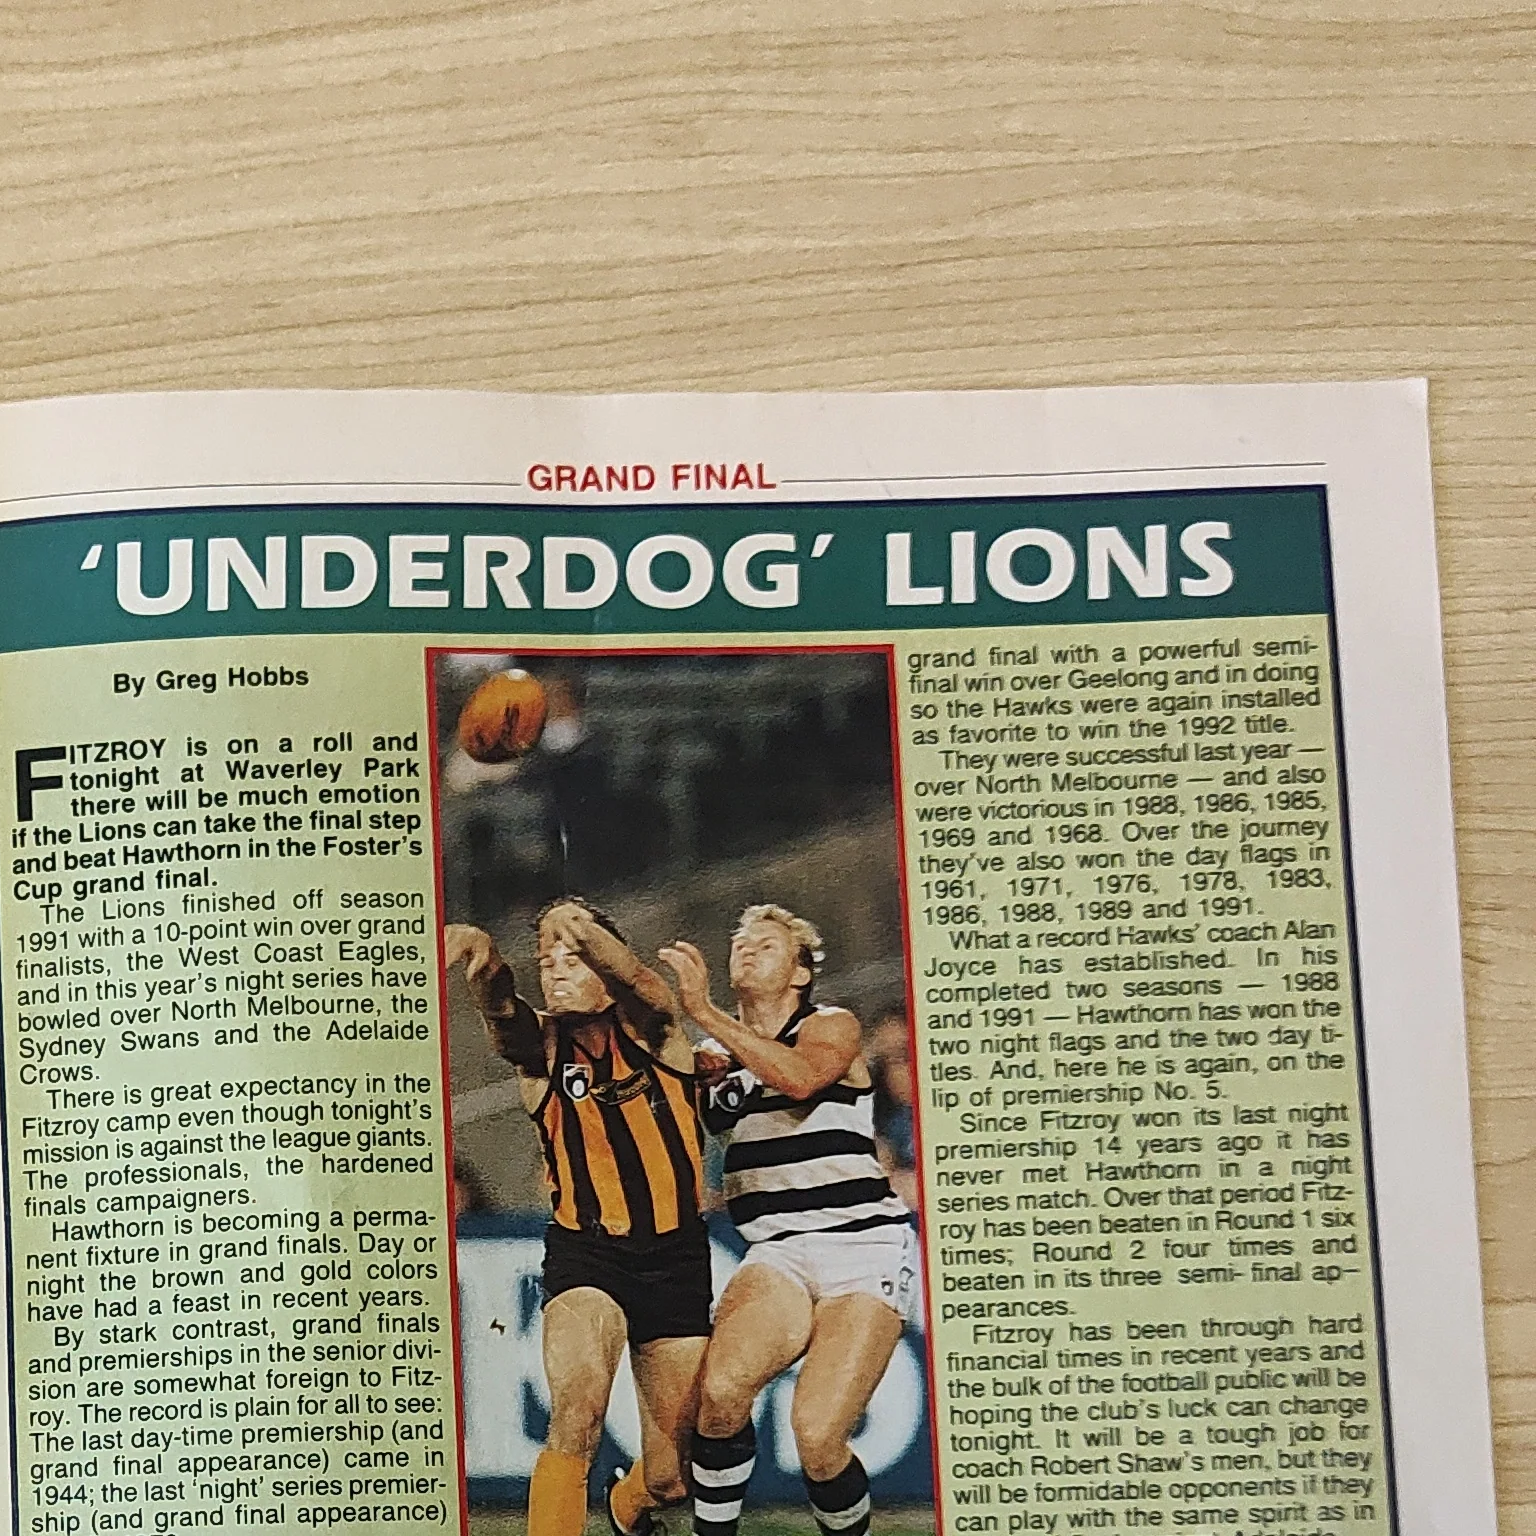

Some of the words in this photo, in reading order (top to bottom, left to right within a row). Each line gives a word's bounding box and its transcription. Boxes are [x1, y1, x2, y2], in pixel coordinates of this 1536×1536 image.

[527, 465, 655, 493] GRAND
[671, 463, 777, 490] FINAL
[886, 521, 1234, 605] LIONS
[114, 674, 145, 697] By
[156, 670, 217, 694] Greg
[229, 666, 309, 687] Hobbs
[910, 704, 938, 720] so
[946, 700, 984, 719] the
[994, 696, 1072, 717] Hawks
[1080, 699, 1139, 715] were
[1148, 693, 1213, 717] again
[1222, 687, 1322, 711] installed
[70, 766, 159, 792] tonight
[181, 764, 204, 783] at
[226, 758, 343, 784] Waverley
[364, 758, 420, 778] Park
[24, 1142, 109, 1165] mission
[116, 1139, 134, 1159] is
[141, 1134, 223, 1161] against
[230, 1131, 266, 1152] the
[273, 1129, 351, 1154] league
[357, 1127, 432, 1152] giants.
